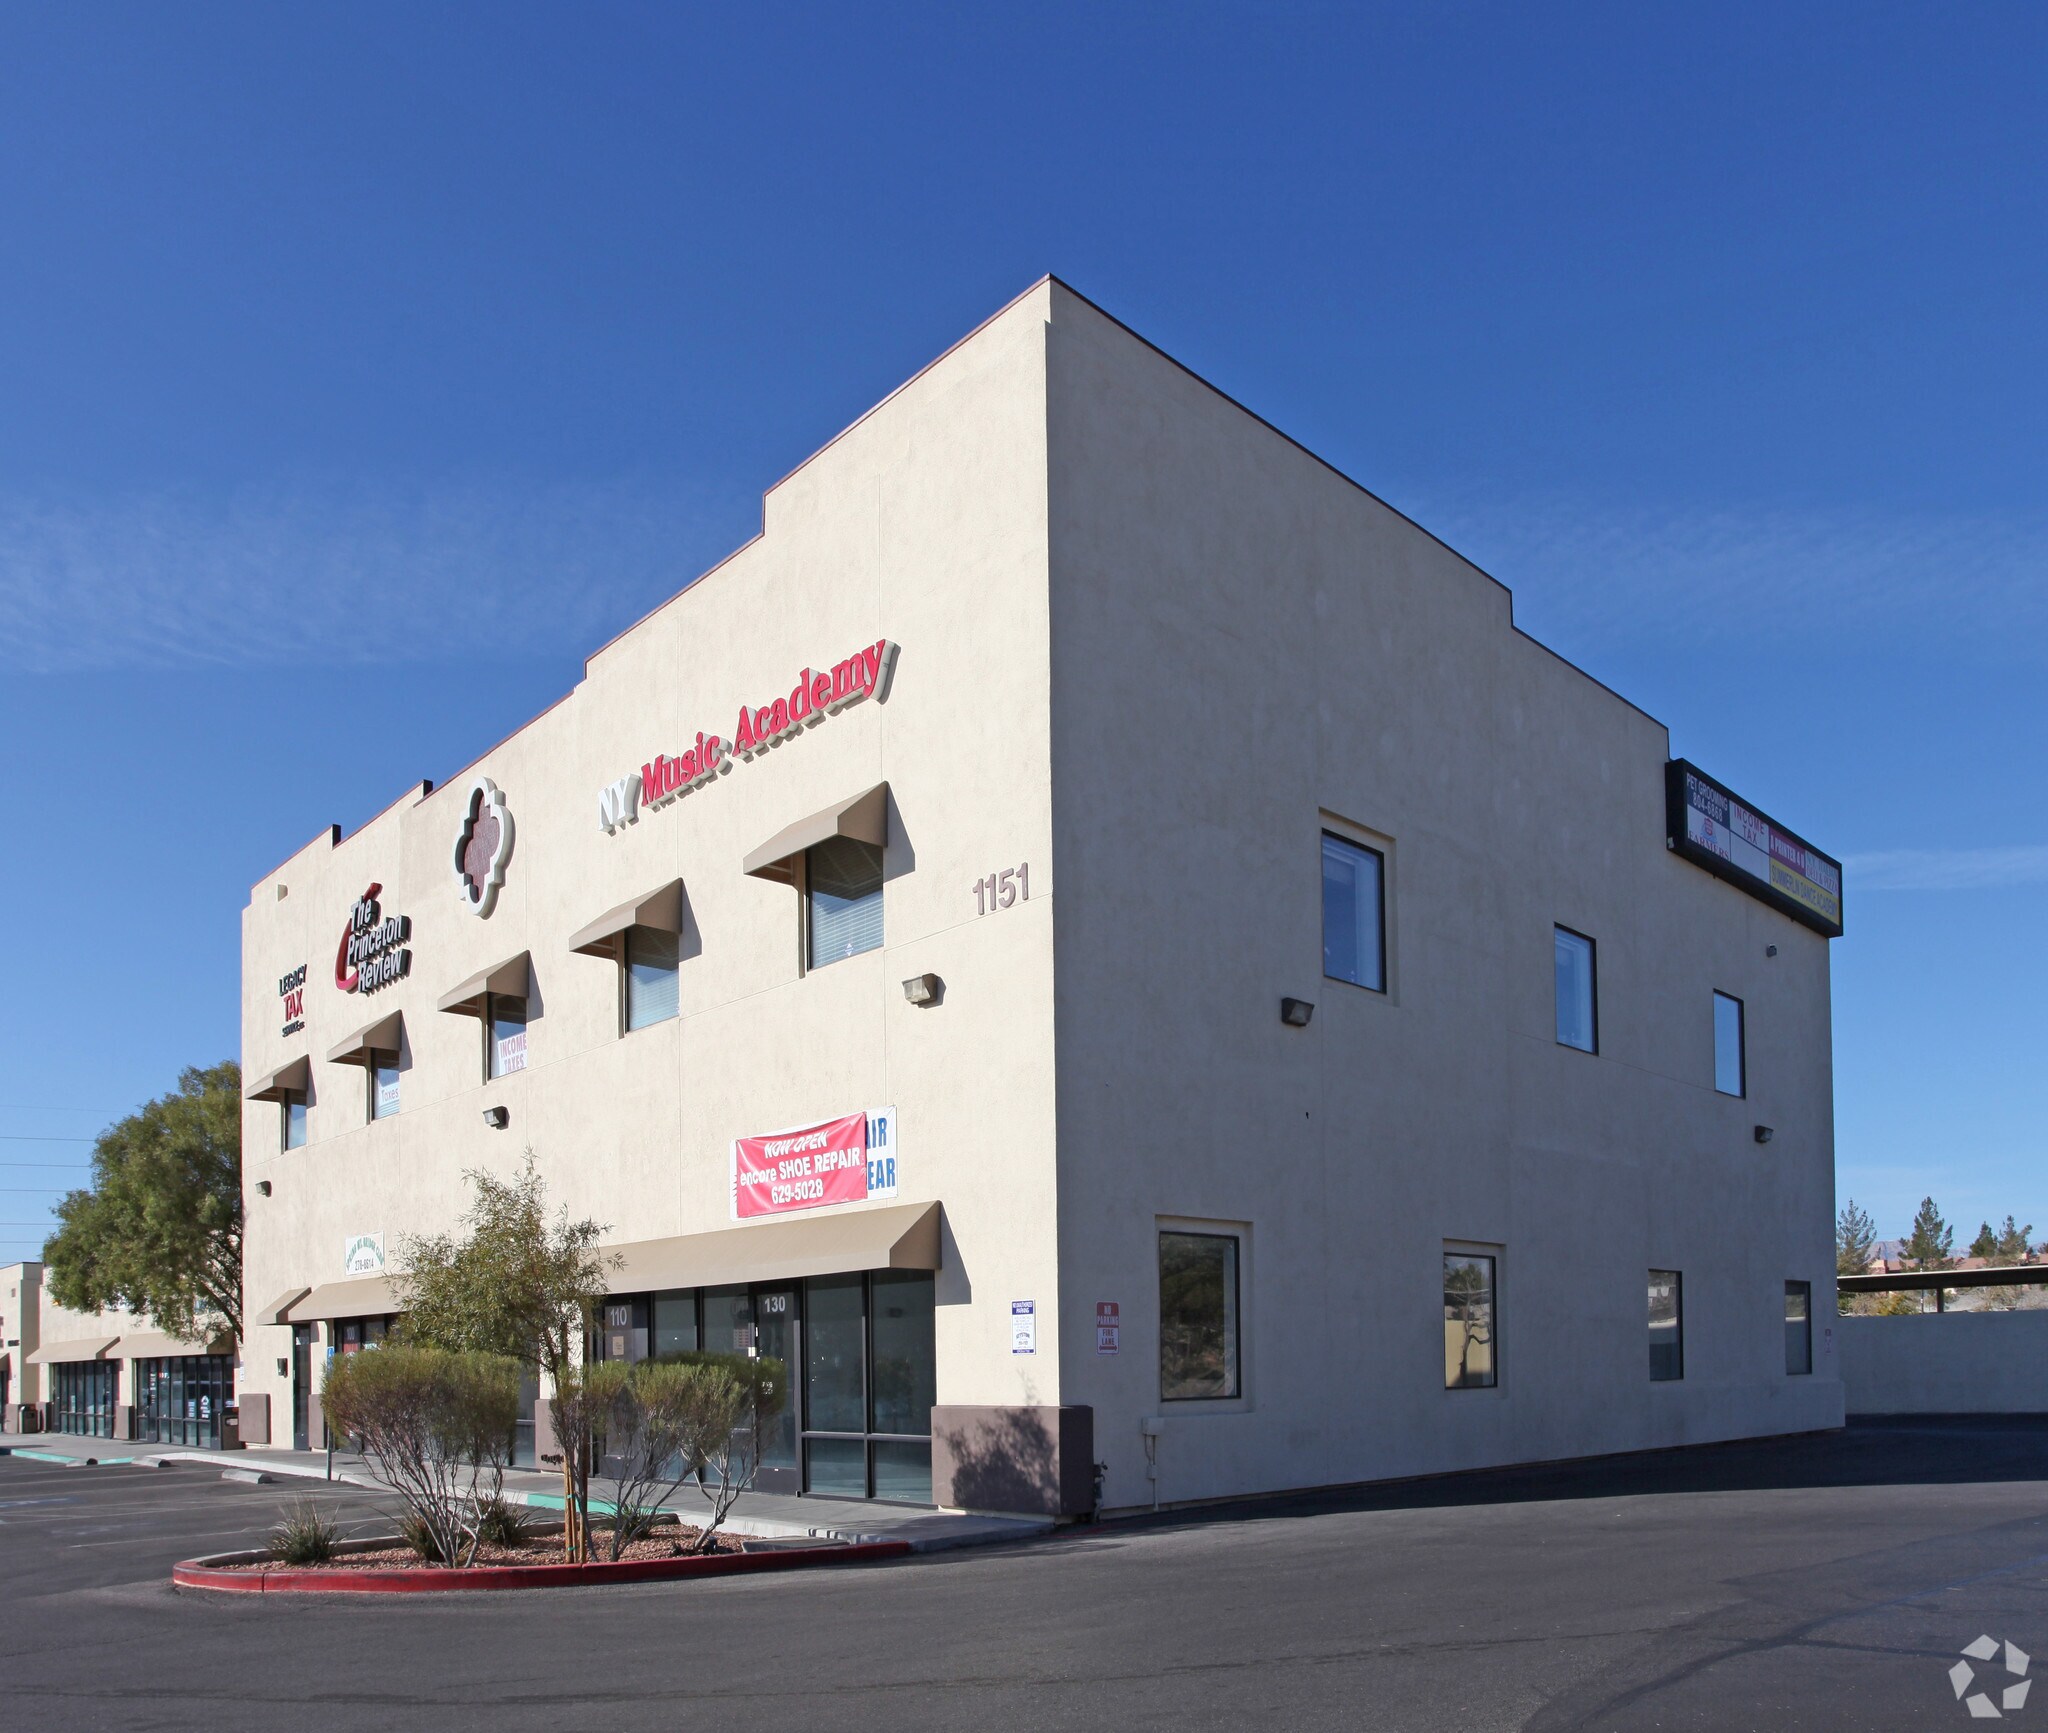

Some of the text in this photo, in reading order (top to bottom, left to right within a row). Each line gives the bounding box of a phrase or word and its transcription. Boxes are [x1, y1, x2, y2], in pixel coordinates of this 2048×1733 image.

[598, 638, 886, 829] NY Music Academy
[1686, 772, 1728, 811] PET GROOMING
[1734, 804, 1765, 835] INCOME
[1743, 824, 1758, 845] TAX
[1689, 830, 1729, 861] FARMERS
[972, 861, 1029, 916] 1151
[350, 894, 372, 933] The
[347, 913, 402, 966] Princeton
[279, 963, 307, 997] LEGACY
[357, 949, 402, 993] Review
[283, 988, 303, 1022] TAX
[500, 1034, 527, 1058] INCOME
[504, 1053, 525, 1074] TAXES
[381, 1088, 399, 1102] Taxes
[764, 1130, 829, 1159] NOW OPEN
[740, 1147, 860, 1187] encore SHOE REPAIR
[771, 1178, 824, 1204] 629-5028
[610, 1306, 627, 1327] 110
[765, 1296, 786, 1313] 130
[1097, 1315, 1119, 1326] PARKING
[1102, 1328, 1114, 1337] FIRE
[1101, 1337, 1115, 1346] LANE
